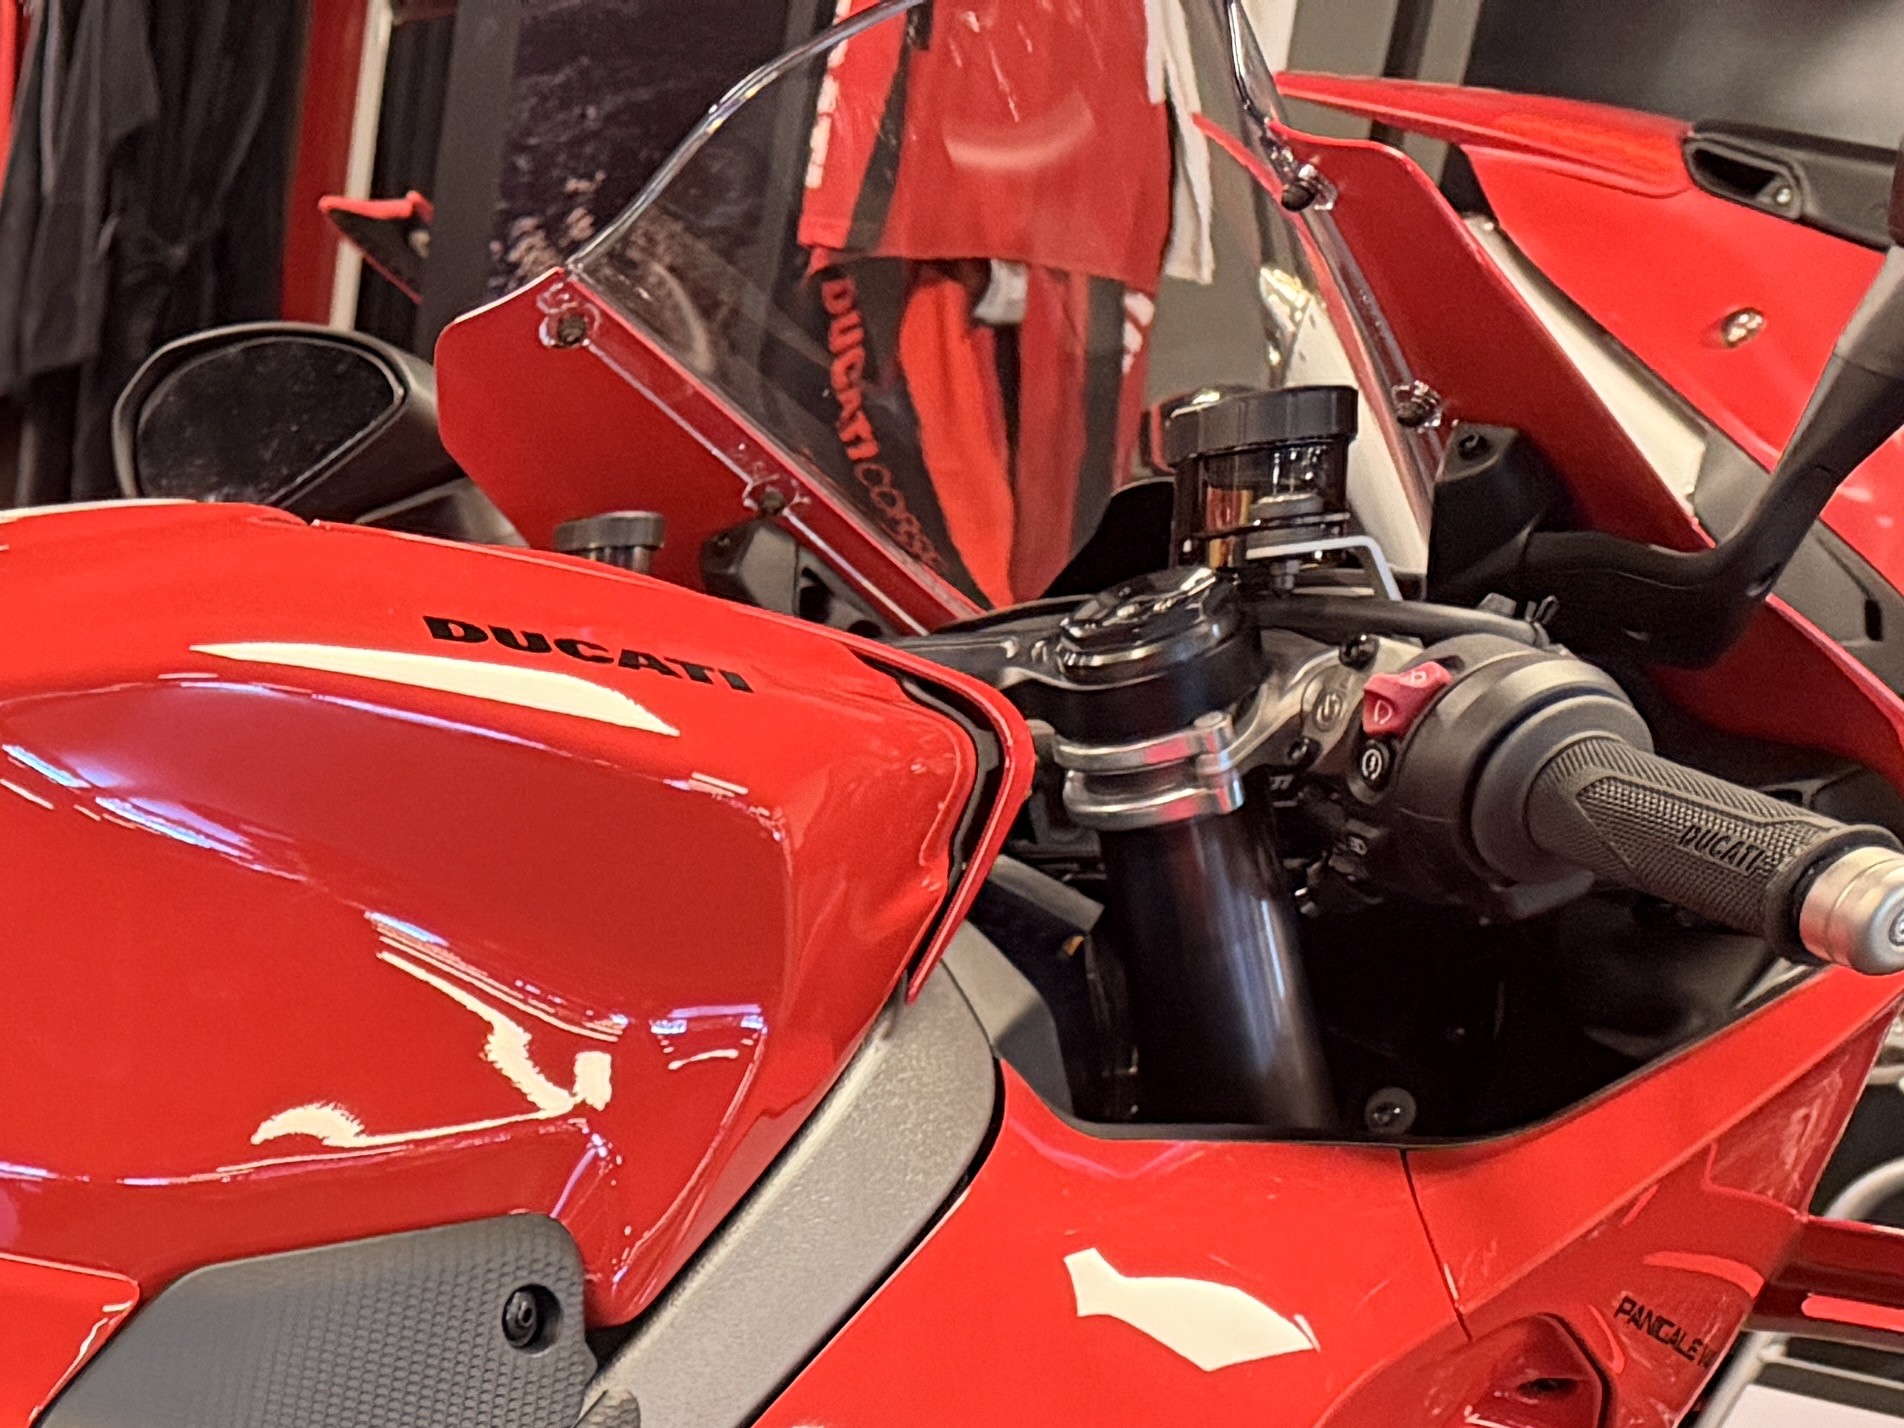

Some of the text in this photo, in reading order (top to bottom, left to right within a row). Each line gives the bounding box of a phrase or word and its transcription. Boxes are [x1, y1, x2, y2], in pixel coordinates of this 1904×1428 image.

[821, 276, 881, 463] DUCATI
[423, 615, 754, 694] DUCATI
[1679, 824, 1768, 873] DUCATI
